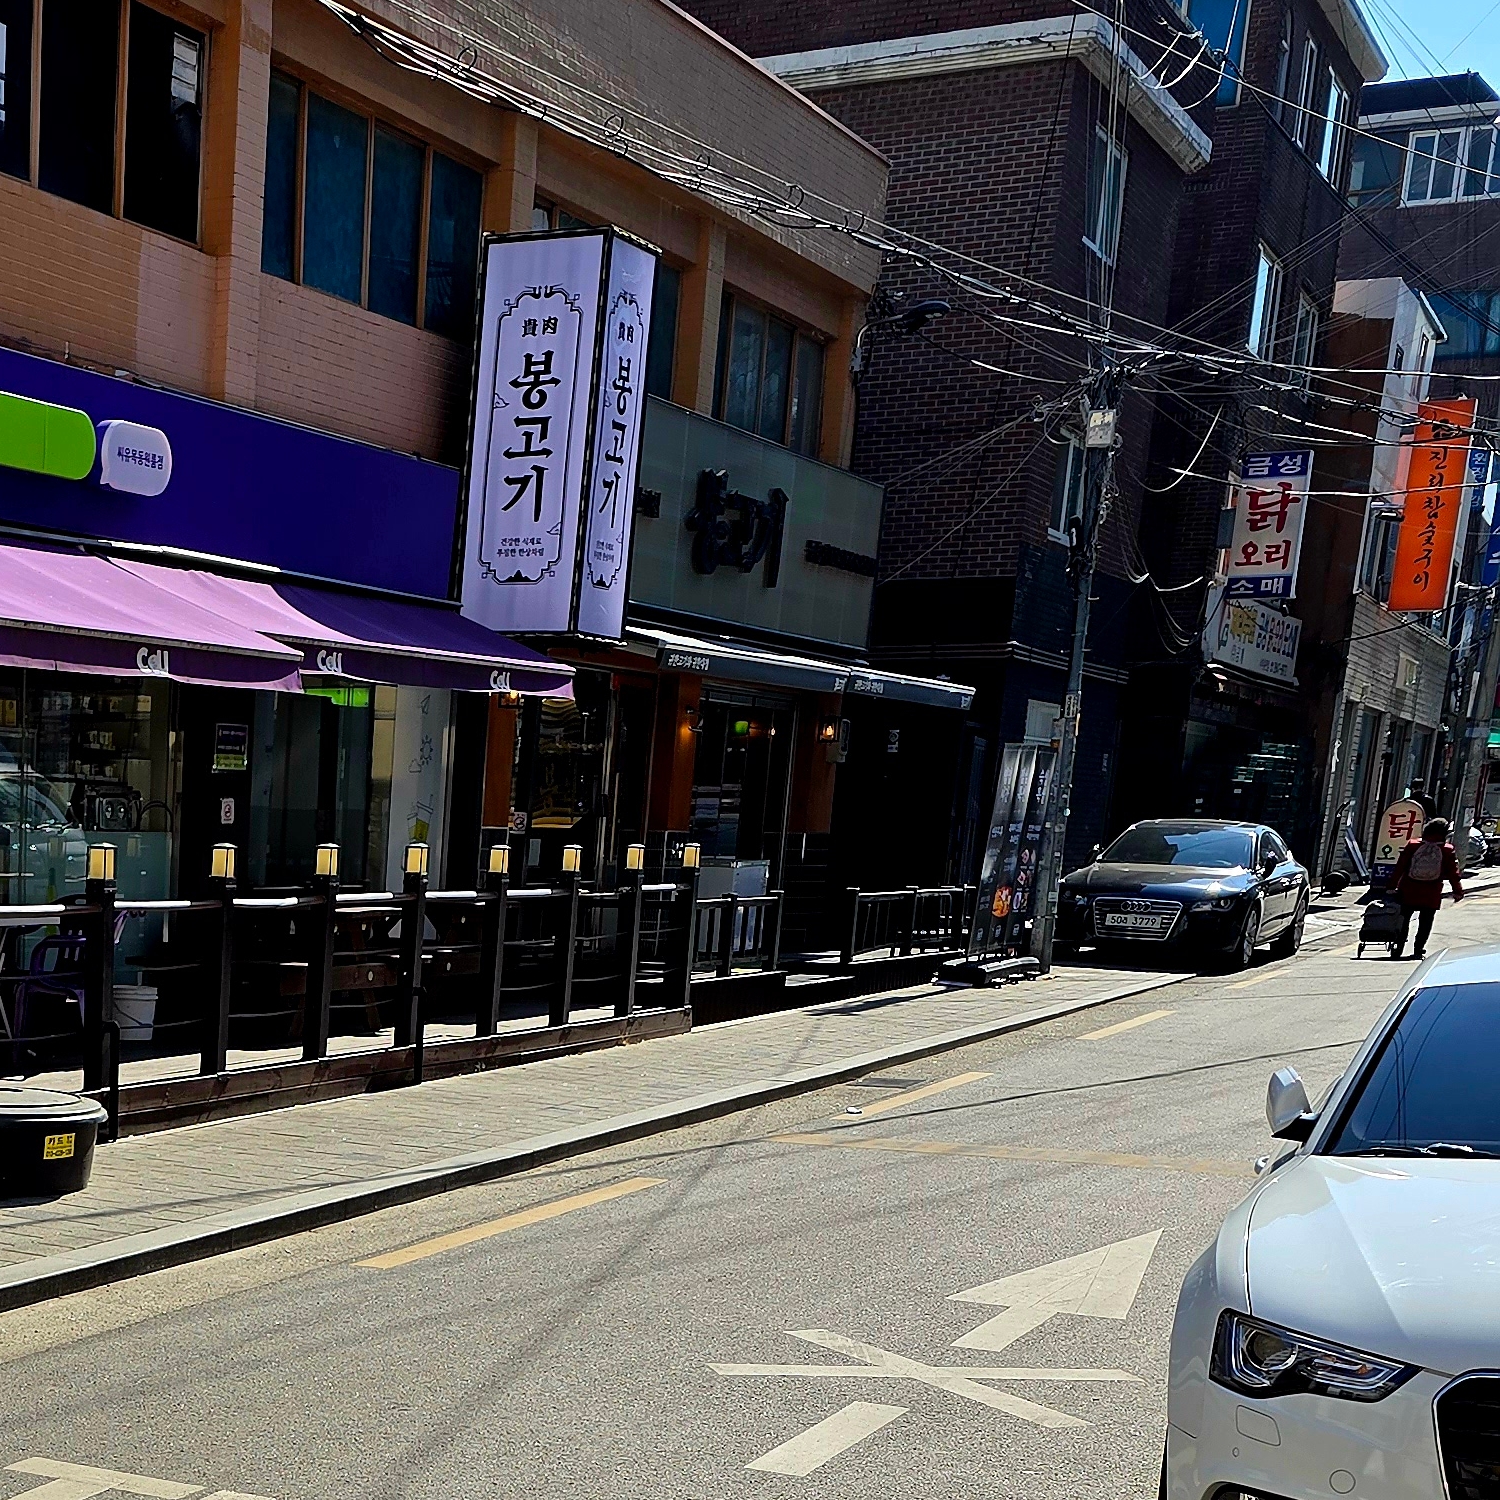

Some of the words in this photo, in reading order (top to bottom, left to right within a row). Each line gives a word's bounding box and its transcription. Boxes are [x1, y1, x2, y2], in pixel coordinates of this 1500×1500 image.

[501, 349, 561, 523] 봉고기
[598, 355, 633, 529] 봉고기
[1247, 452, 1303, 476] 금성
[1246, 481, 1301, 534] 닭
[1234, 540, 1292, 570] 오리
[1229, 577, 1285, 595] 소매
[1388, 810, 1421, 840] 닭
[1131, 916, 1157, 927] 3779
